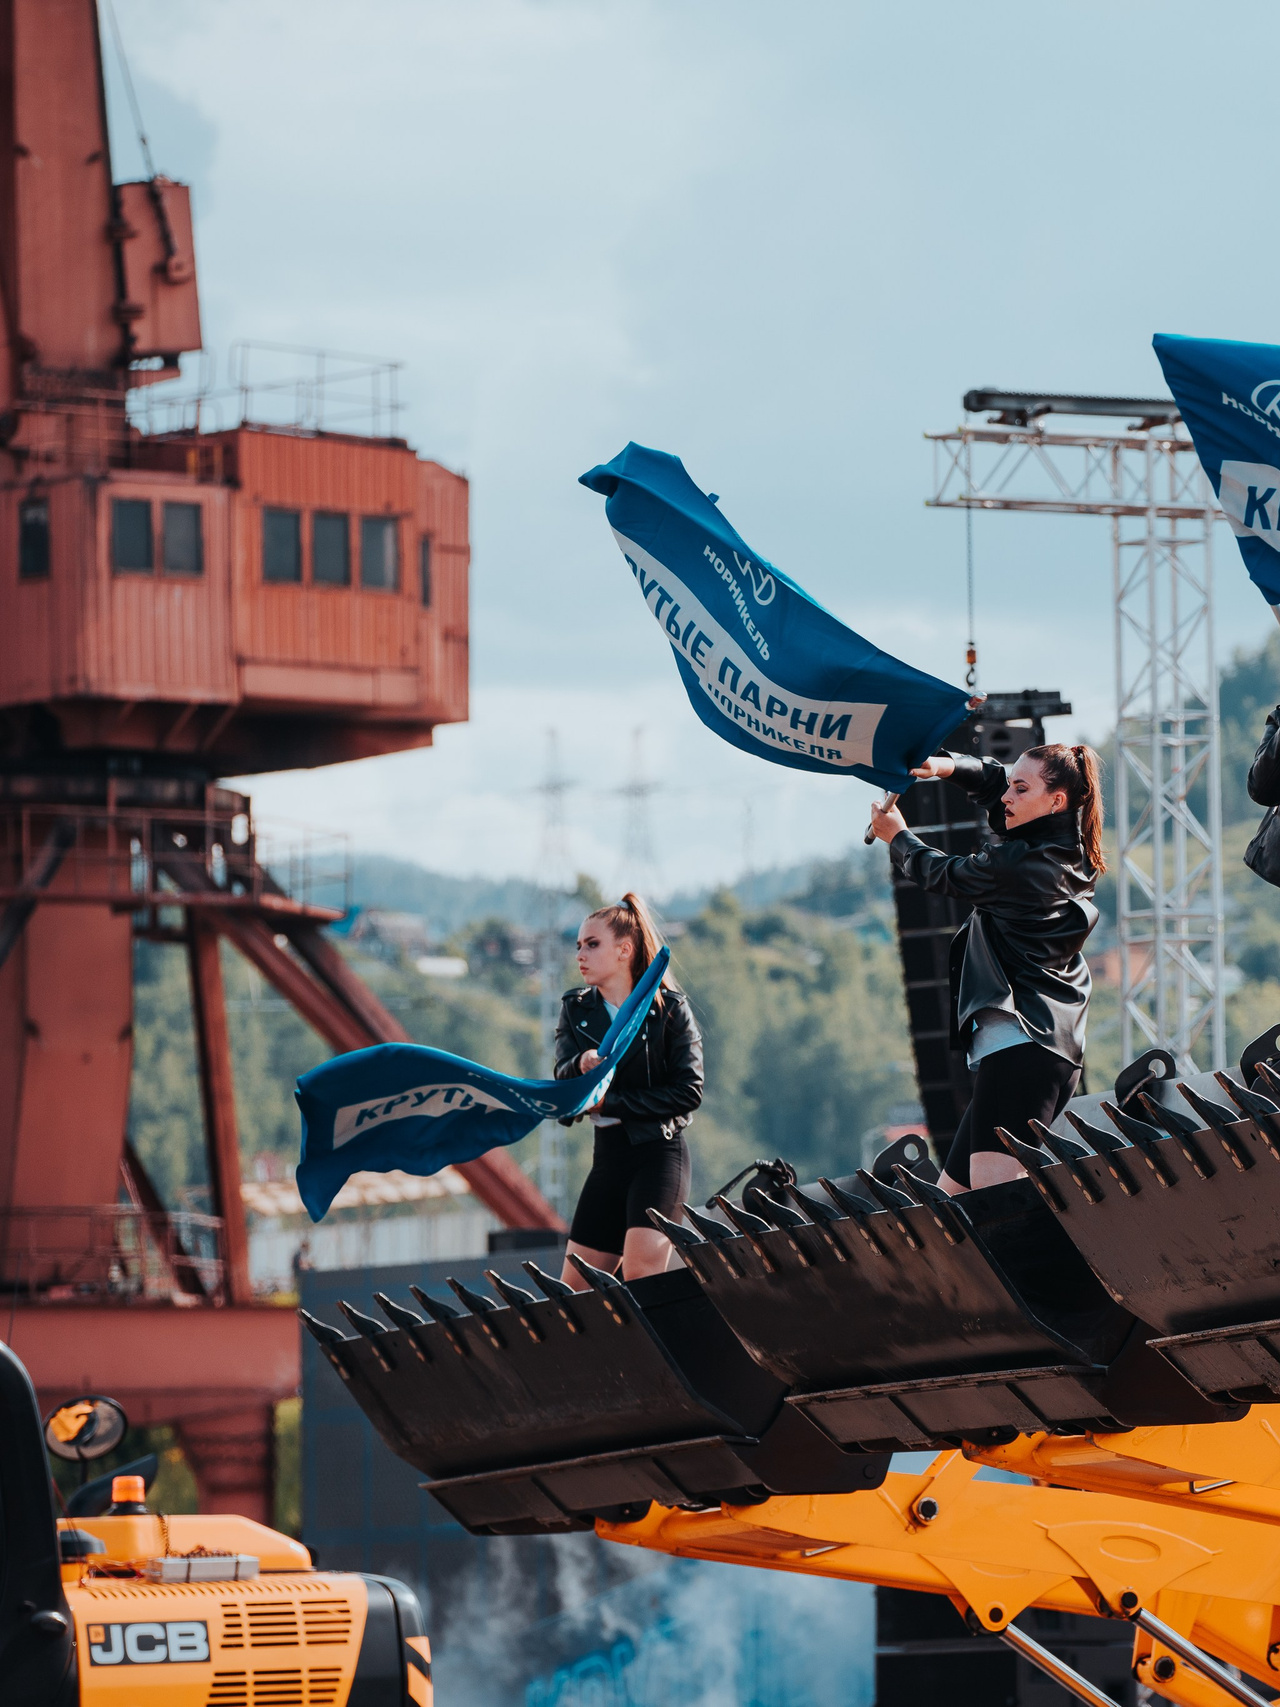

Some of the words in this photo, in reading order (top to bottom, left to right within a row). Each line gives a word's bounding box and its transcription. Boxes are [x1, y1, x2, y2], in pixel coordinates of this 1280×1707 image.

[624, 553, 714, 669] УТЫЕ
[718, 657, 853, 741] ПАРНИ
[703, 545, 771, 661] НОРНИКЕЛЬ
[91, 1621, 209, 1665] JCB
